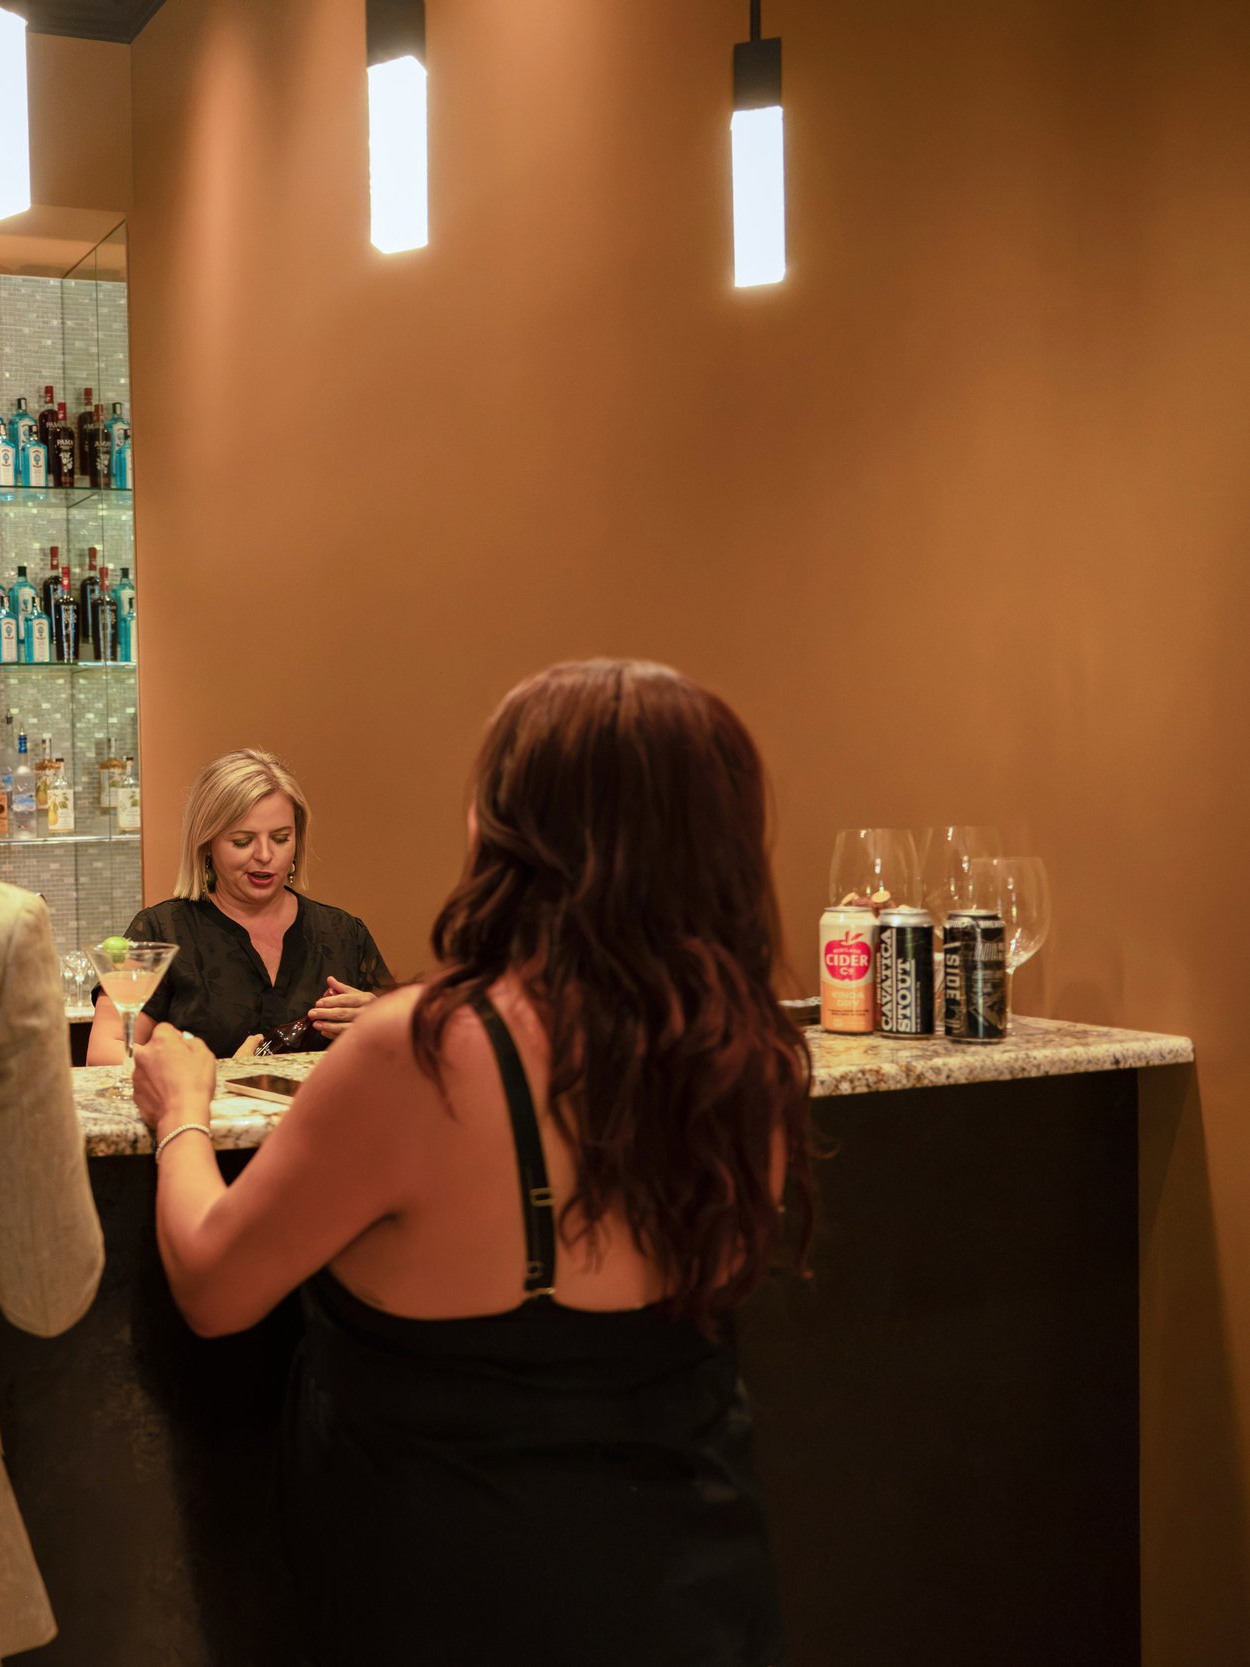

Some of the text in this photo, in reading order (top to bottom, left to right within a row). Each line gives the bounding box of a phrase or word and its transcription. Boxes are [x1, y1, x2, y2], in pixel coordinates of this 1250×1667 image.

[826, 953, 869, 967] CIDER
[880, 928, 893, 1031] CAVATICA
[945, 953, 961, 1001] SIDE
[897, 958, 911, 1032] STOUT
